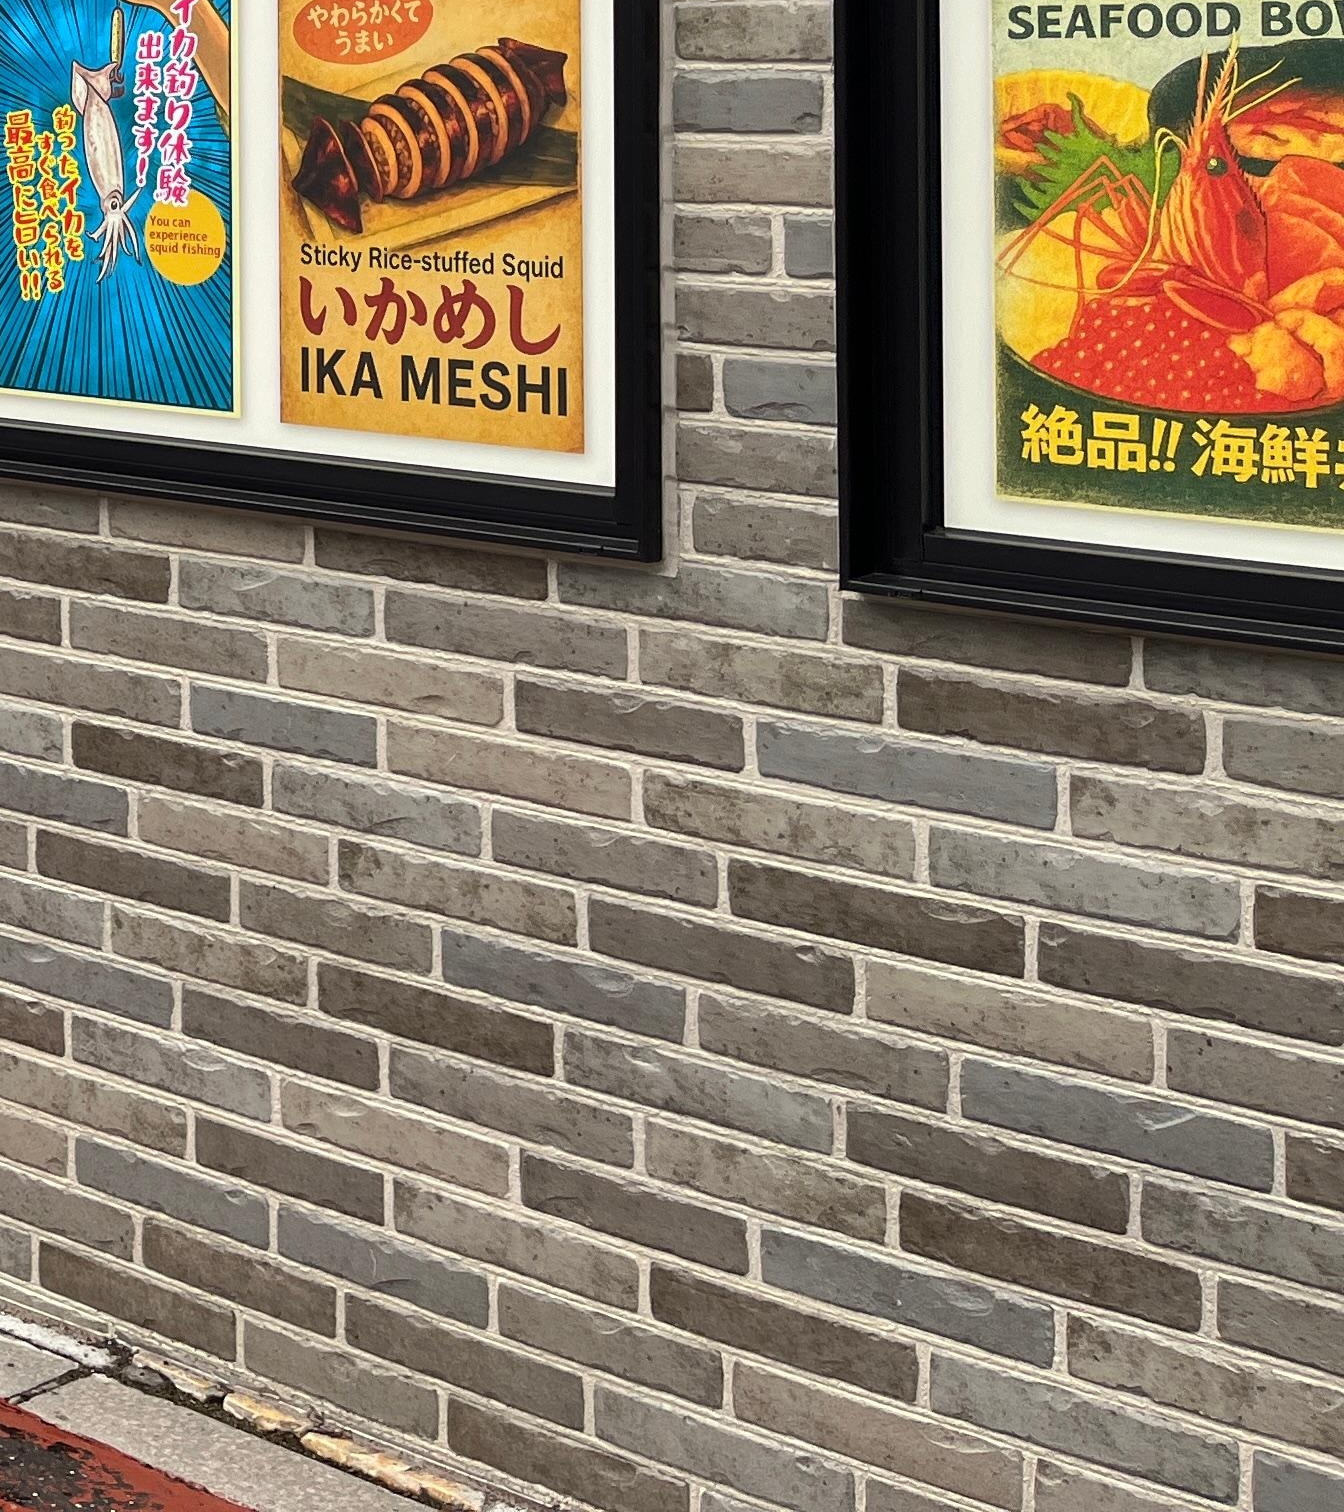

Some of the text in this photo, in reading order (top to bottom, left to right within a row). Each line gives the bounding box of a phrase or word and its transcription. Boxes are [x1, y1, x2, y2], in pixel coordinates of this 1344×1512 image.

[334, 31, 394, 57] うまい
[1007, 0, 1344, 39] SEAFOOD BO
[132, 32, 162, 187] 出来ます!
[4, 109, 42, 301] 最高に旨い!!
[35, 130, 65, 293] すぐ食べられる
[53, 104, 86, 260] 釣ったイカを
[149, 215, 191, 228] You can
[149, 230, 208, 243] experience
[149, 243, 222, 259] squid fishing
[300, 243, 565, 282] Sticky Rice-stuffed Squid
[298, 275, 562, 356] いかめし
[300, 346, 569, 417] IKA MESHI
[1020, 403, 1344, 490] 絶品!! 海鮮
